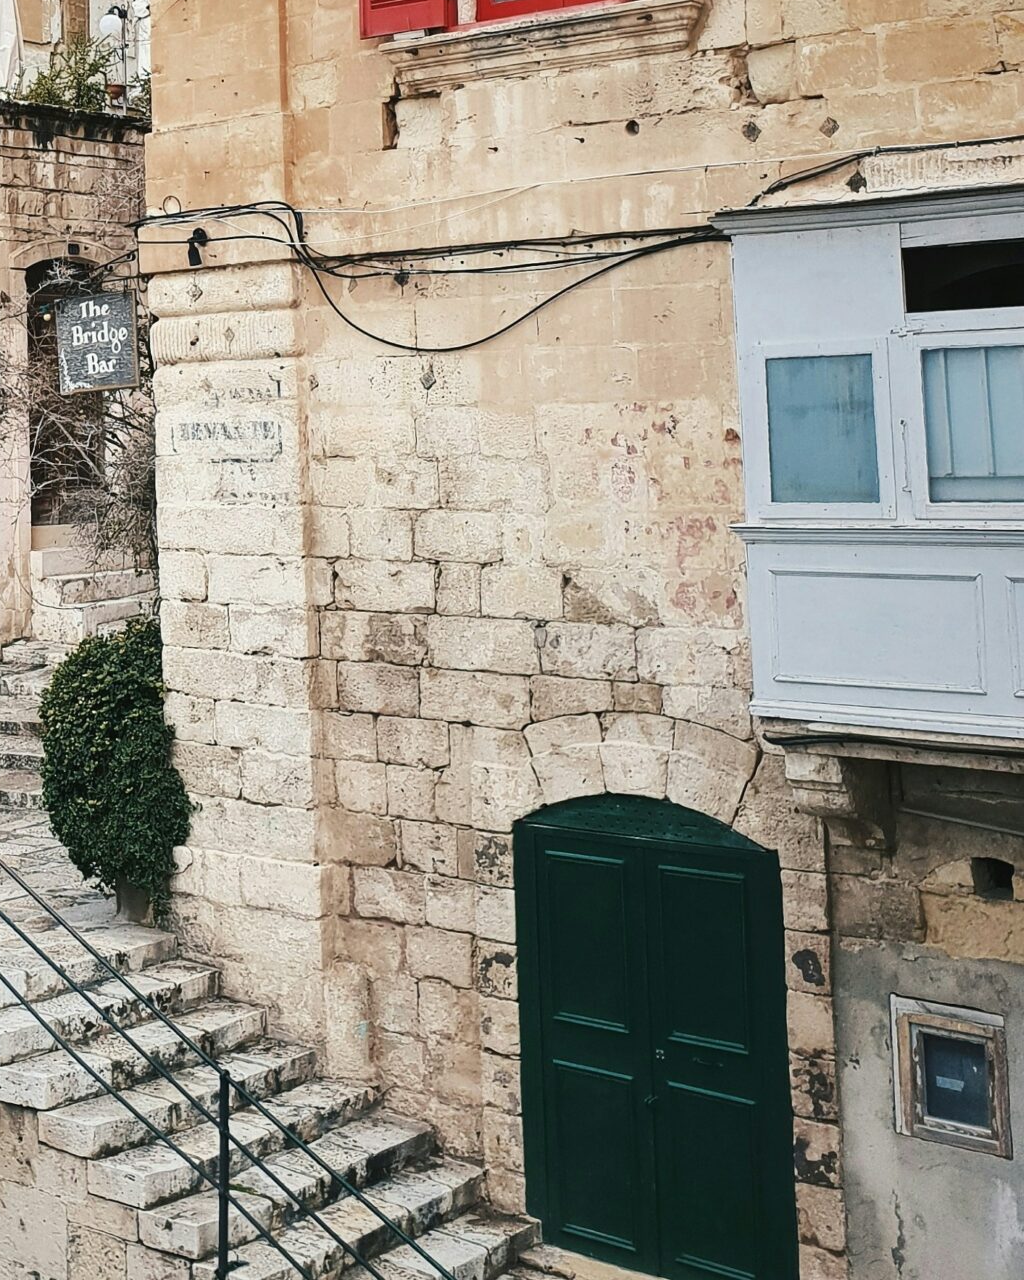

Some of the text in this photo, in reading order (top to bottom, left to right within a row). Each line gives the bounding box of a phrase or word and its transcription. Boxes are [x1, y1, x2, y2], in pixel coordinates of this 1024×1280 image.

[79, 300, 111, 318] The
[71, 321, 129, 354] Bridge
[85, 352, 117, 375] Bar
